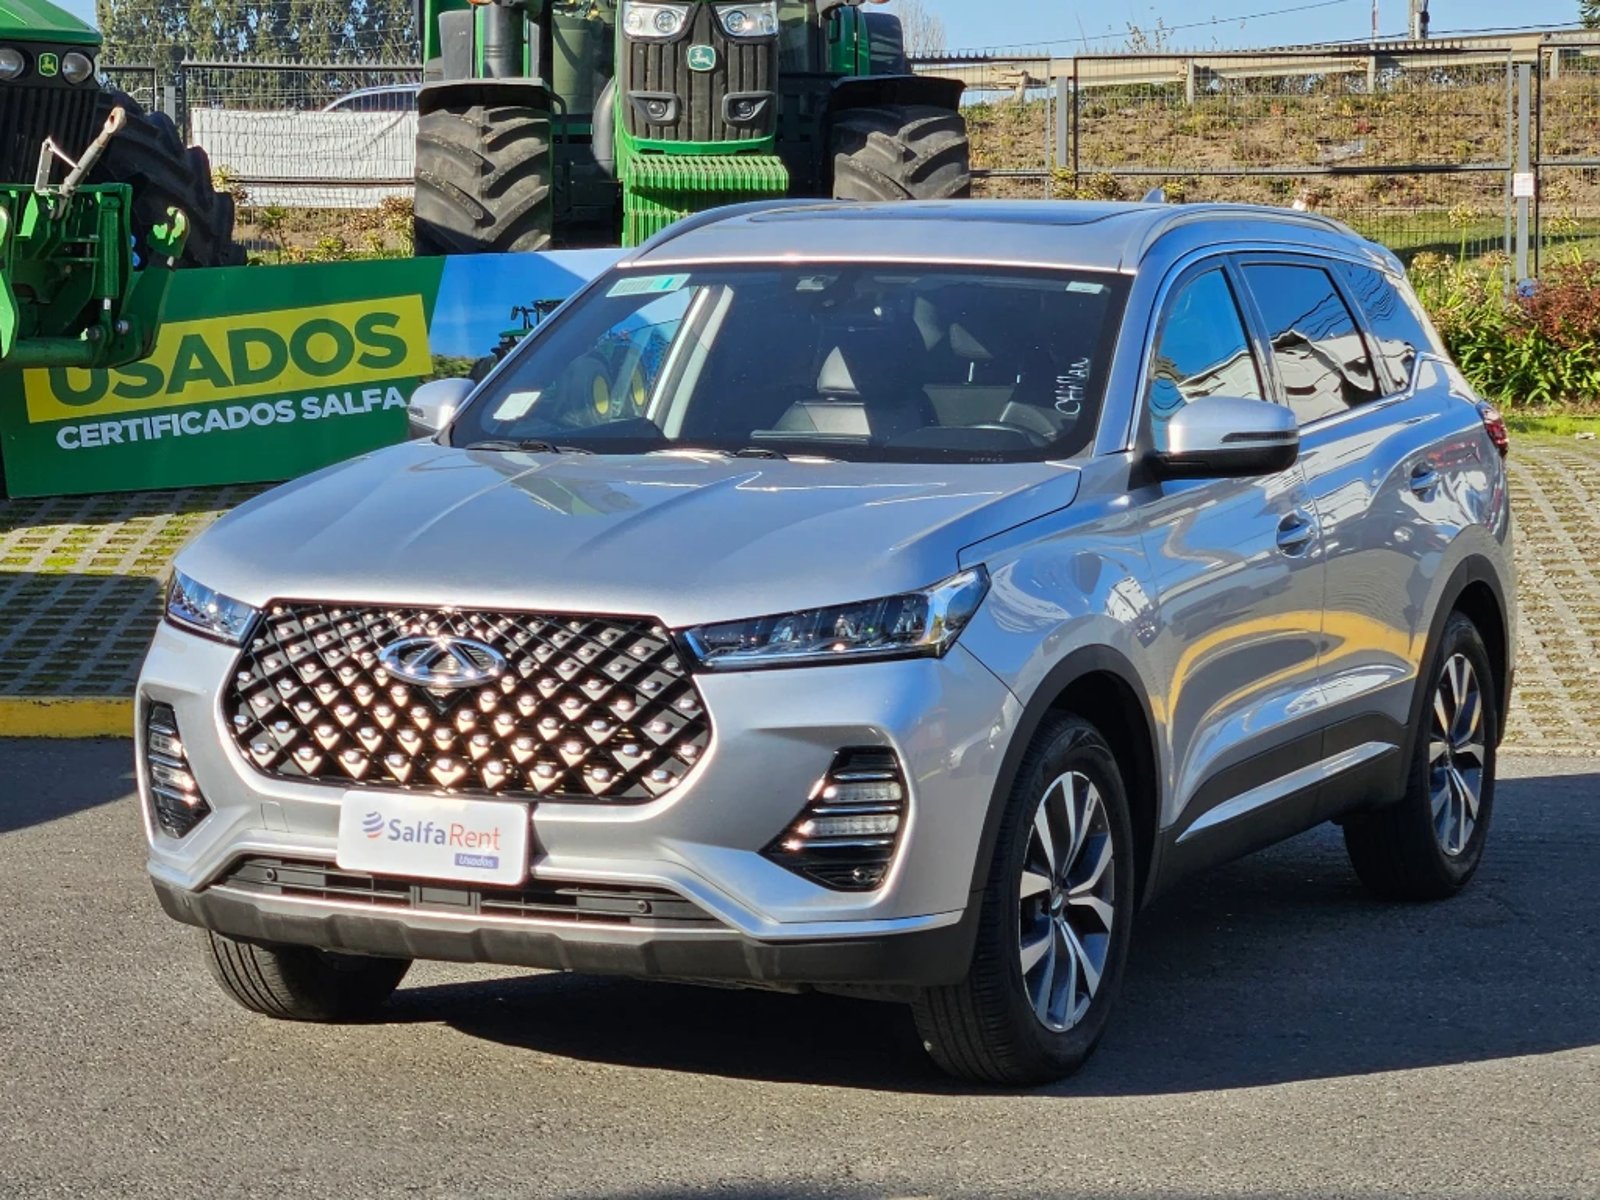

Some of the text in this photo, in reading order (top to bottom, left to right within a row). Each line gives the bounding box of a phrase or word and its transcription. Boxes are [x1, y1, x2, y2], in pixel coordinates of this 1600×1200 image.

[48, 312, 408, 406] USADOS
[56, 386, 407, 449] CERTIFICADOS SALFA
